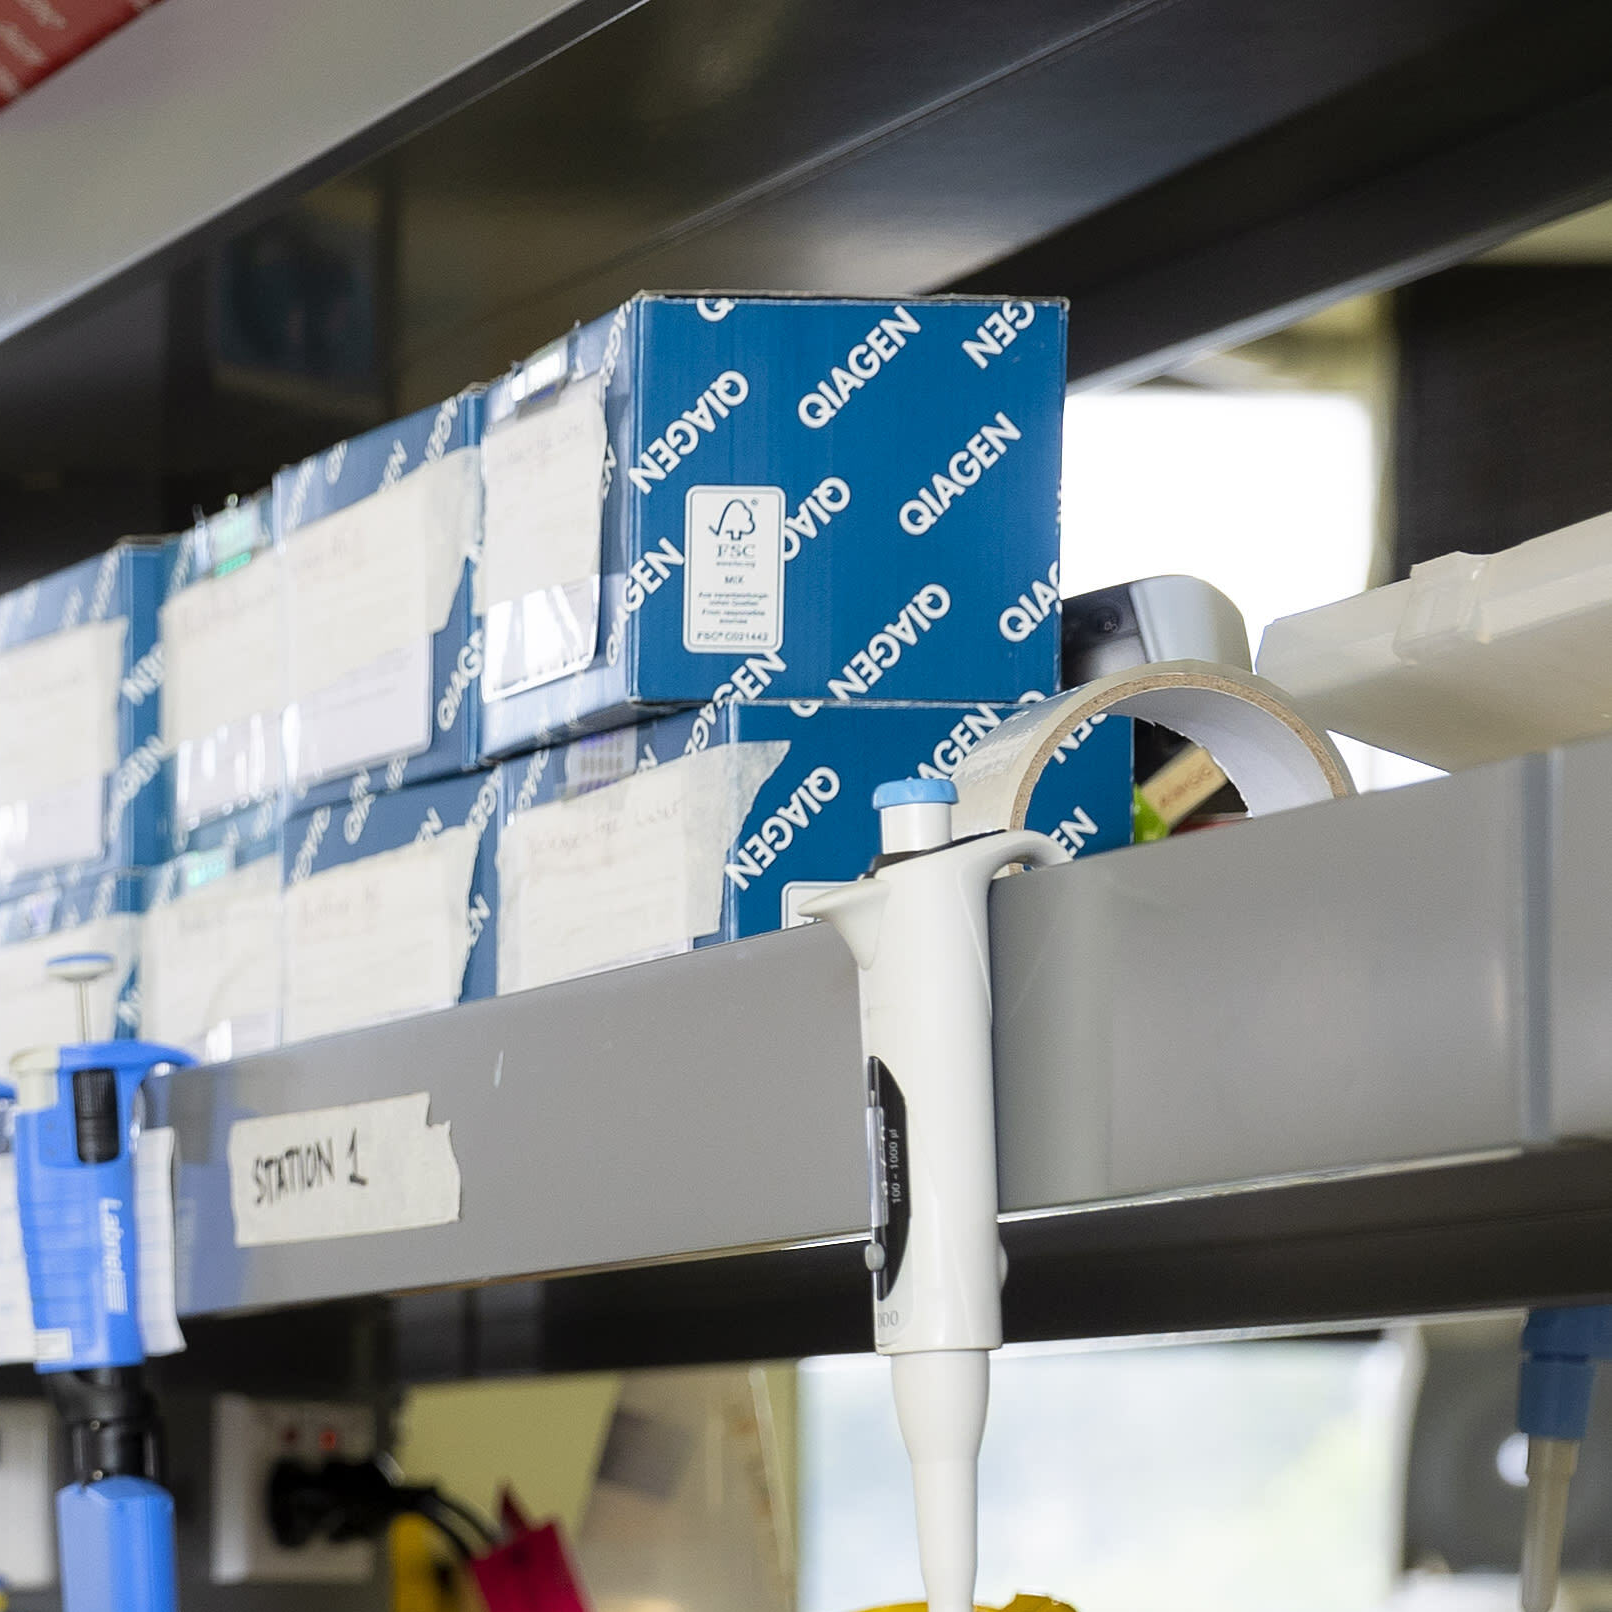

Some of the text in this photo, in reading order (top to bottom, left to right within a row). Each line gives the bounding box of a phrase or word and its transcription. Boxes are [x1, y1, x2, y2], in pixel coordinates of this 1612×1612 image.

[797, 304, 922, 429] QIAGEN
[628, 370, 749, 495] QIAGEN
[898, 411, 1022, 536] QIAGEN
[606, 537, 686, 668] QIAGEN
[827, 583, 952, 702] QIAGEN
[725, 766, 841, 892] QIAGEN
[251, 1126, 369, 1206] STATION 1
[889, 1141, 900, 1170] 1000
[890, 1183, 902, 1204] 100
